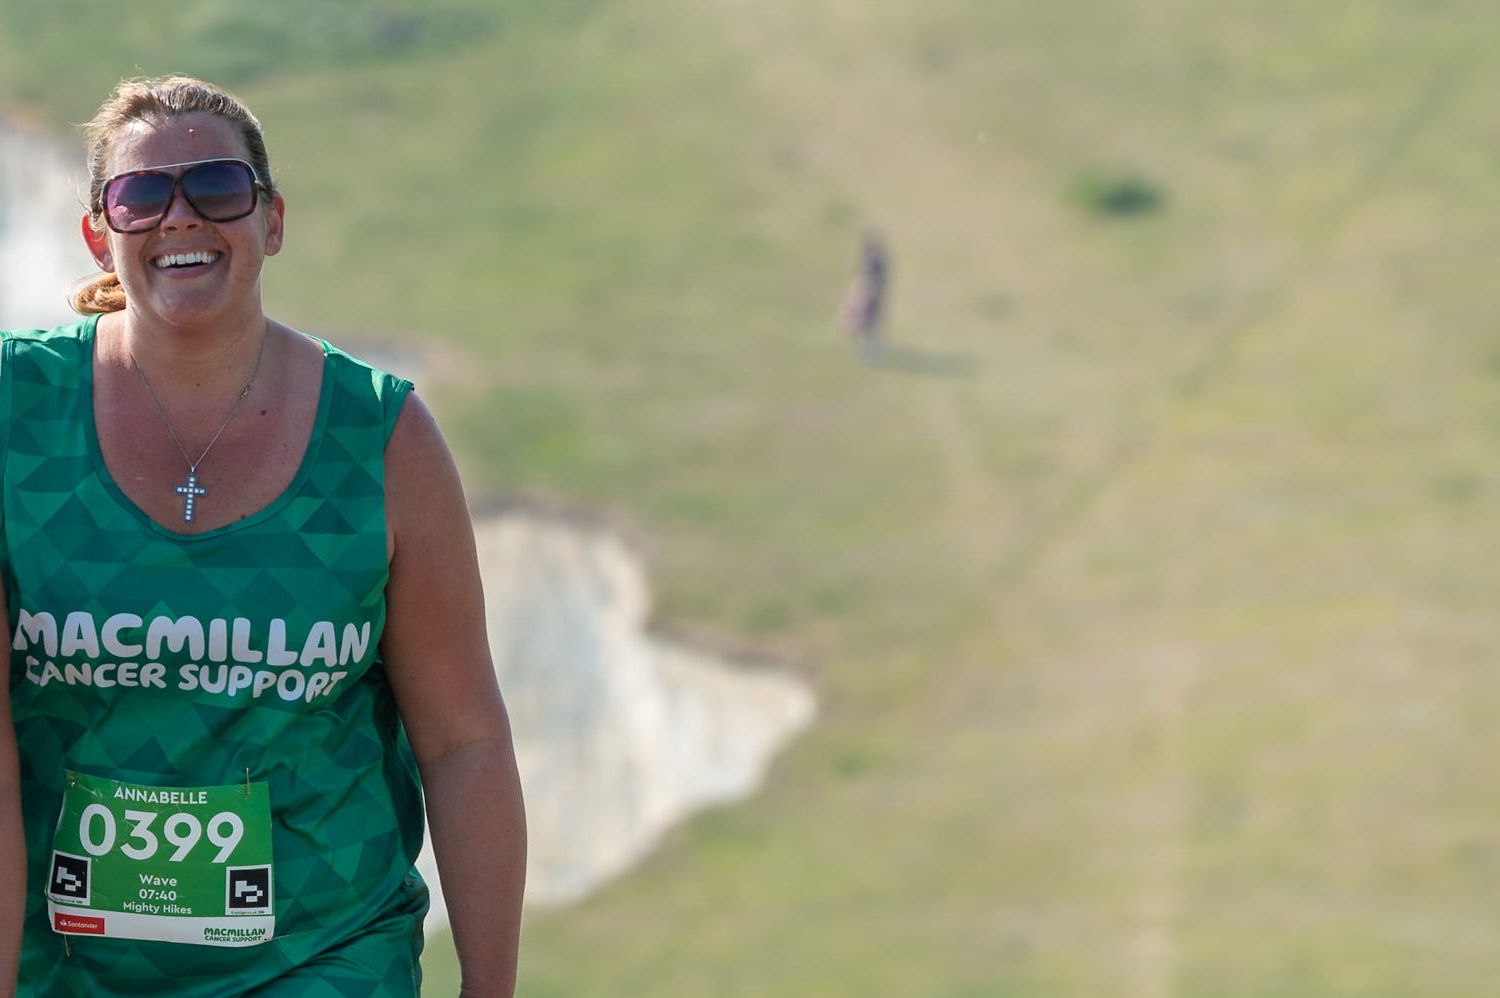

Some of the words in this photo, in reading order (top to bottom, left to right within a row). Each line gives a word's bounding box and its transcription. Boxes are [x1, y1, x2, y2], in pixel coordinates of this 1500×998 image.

[12, 608, 371, 668] MACMILLAN
[25, 655, 167, 689] CANCER
[178, 664, 348, 704] SUPPORT
[113, 785, 208, 806] ANNABELLE
[78, 803, 245, 865] 0399
[139, 873, 178, 887] Wave
[138, 888, 177, 901] 07:40
[123, 901, 160, 914] Mighty
[163, 904, 193, 915] Hikes
[67, 920, 98, 930] Santander
[204, 927, 266, 937] MACMILLAN
